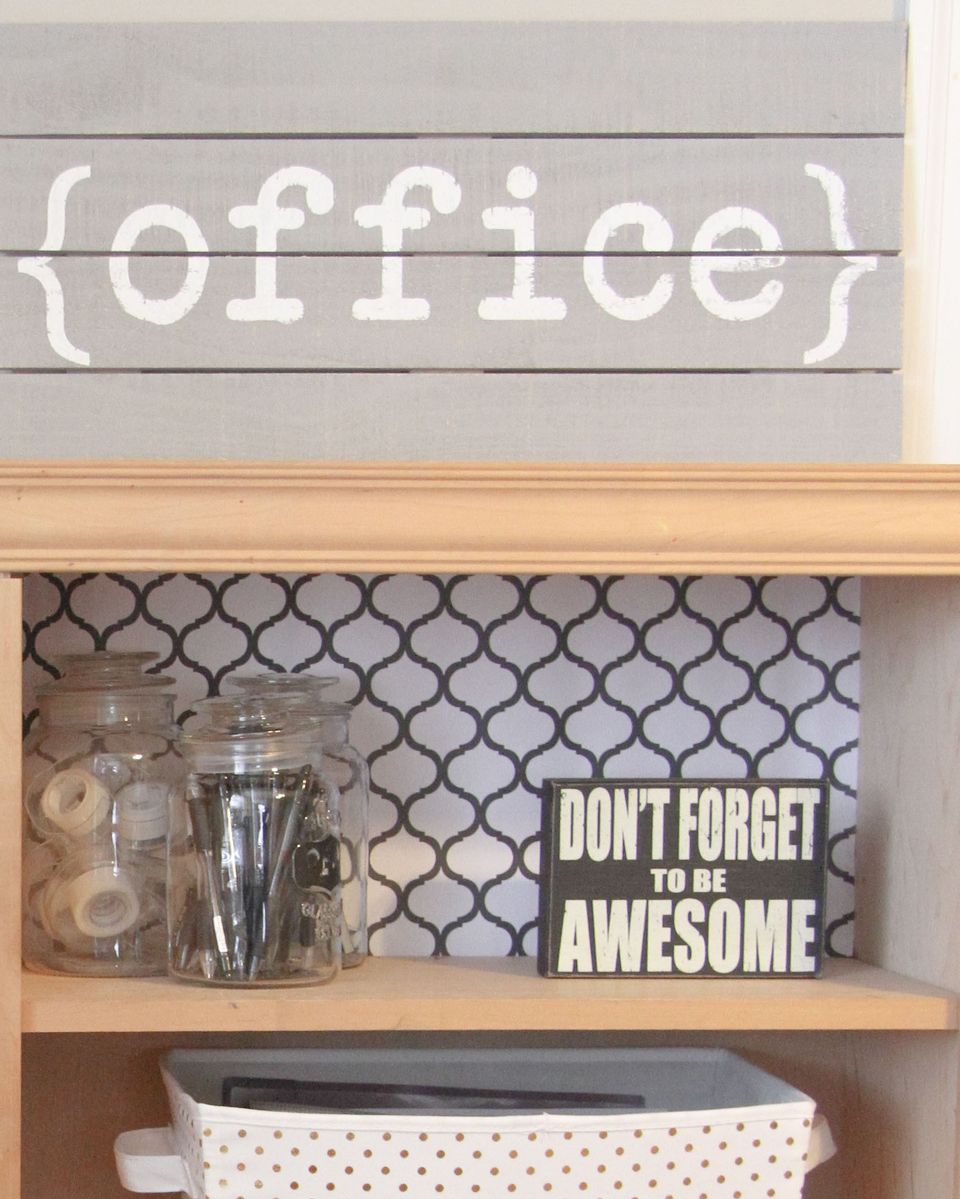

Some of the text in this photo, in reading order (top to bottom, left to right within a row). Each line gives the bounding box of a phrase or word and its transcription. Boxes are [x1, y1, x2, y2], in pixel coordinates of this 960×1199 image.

[559, 786, 821, 862] DON'T FORGET
[650, 868, 727, 893] TO BE
[557, 898, 816, 974] AWESOME
